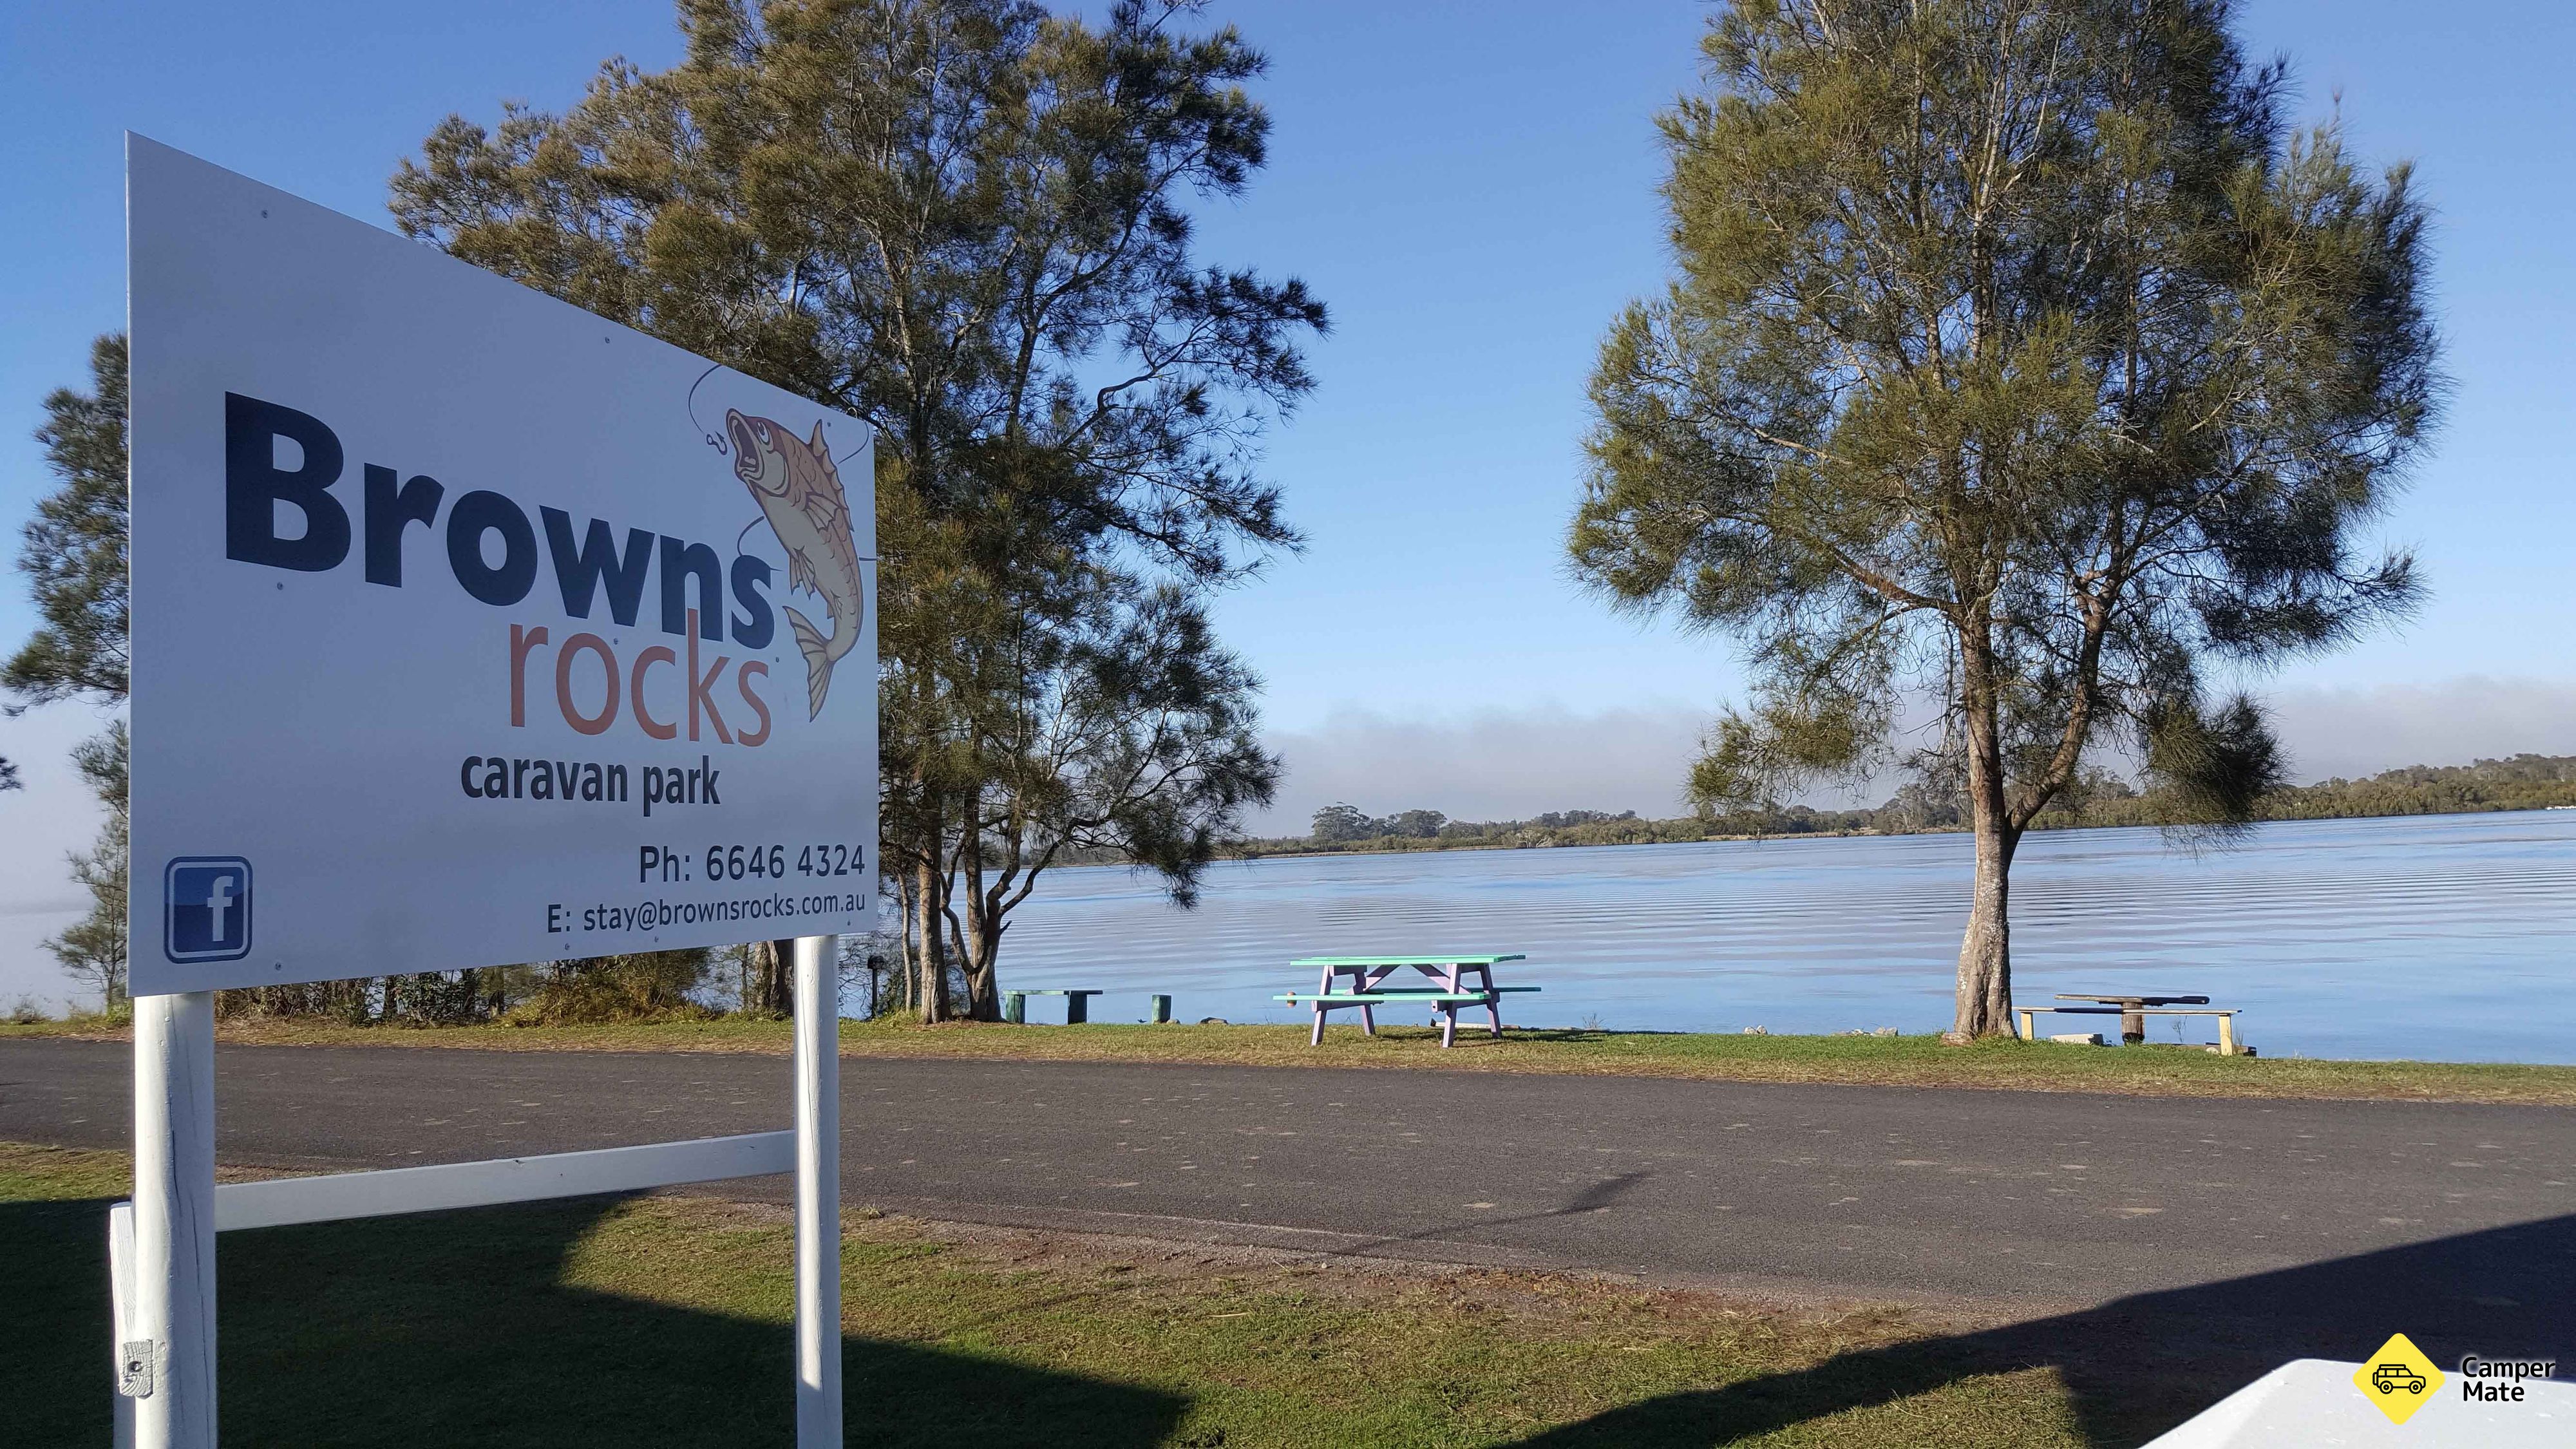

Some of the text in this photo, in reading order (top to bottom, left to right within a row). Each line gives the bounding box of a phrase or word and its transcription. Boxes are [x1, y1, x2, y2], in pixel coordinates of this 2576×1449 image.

[225, 390, 775, 649] Browns
[509, 608, 773, 748] rocks
[460, 754, 721, 817] caravan park
[639, 844, 866, 884] Ph: 6646 4324
[547, 891, 866, 933] E: stay@brownsrocks.com.au
